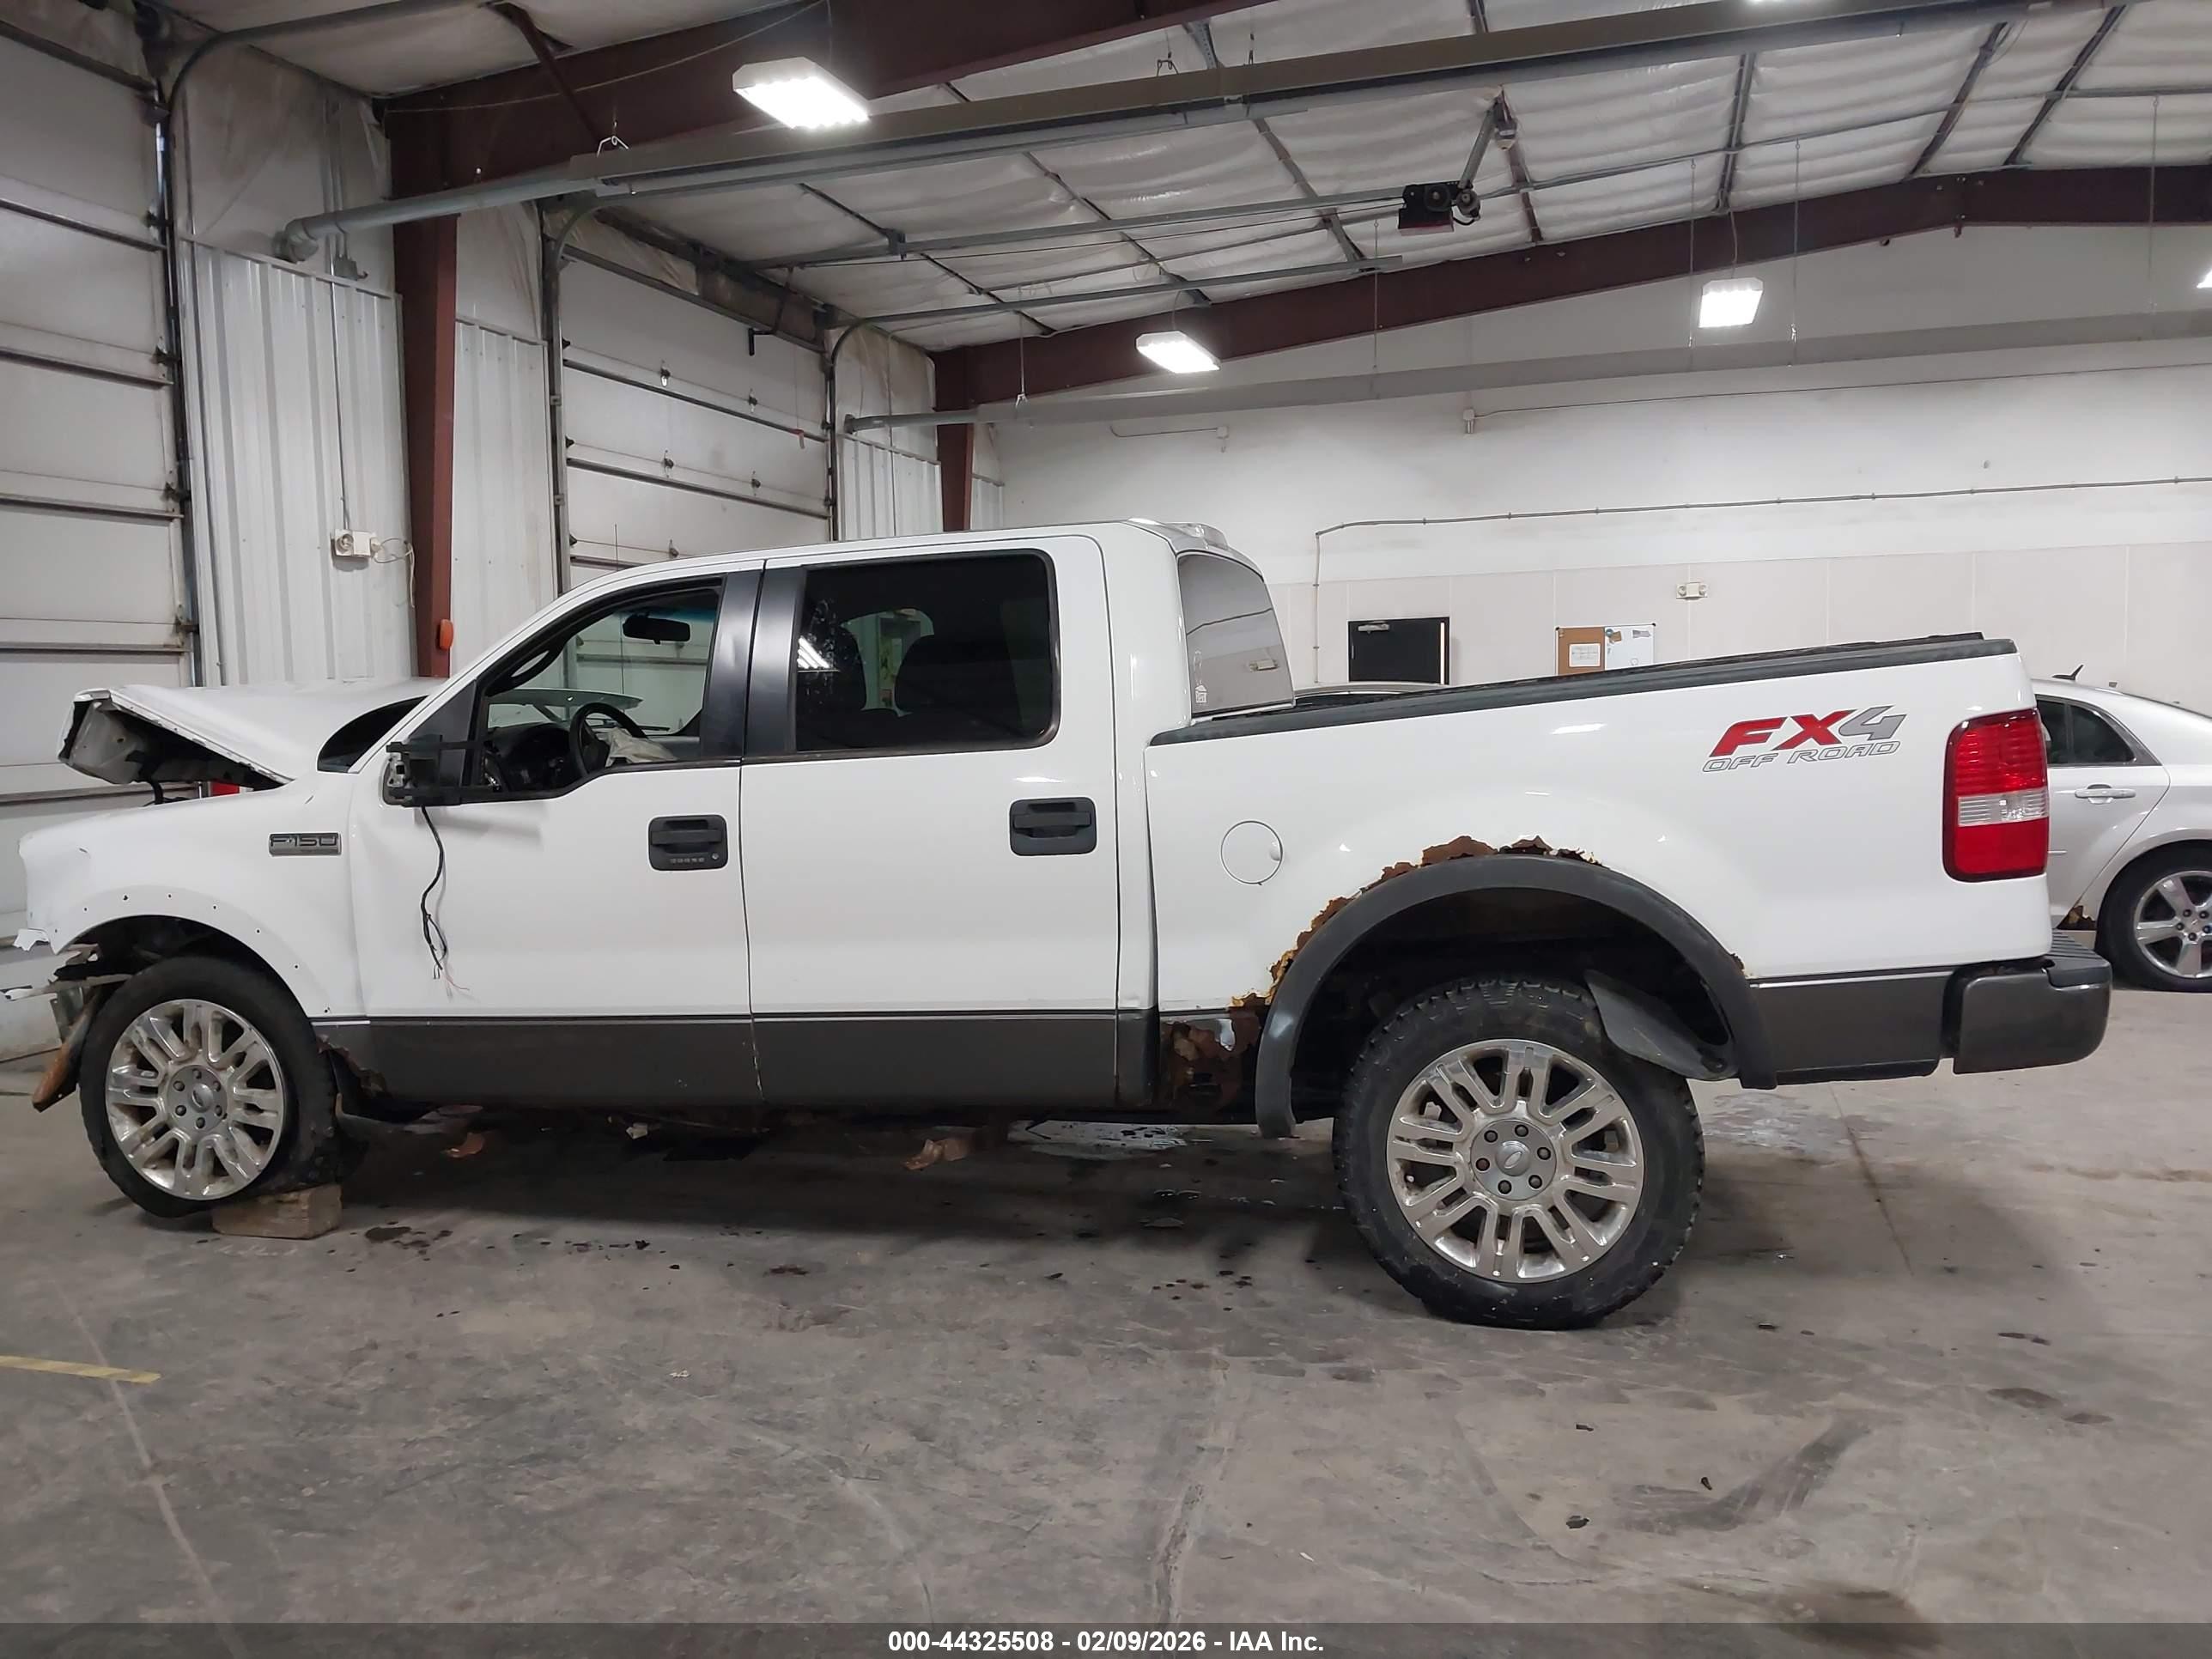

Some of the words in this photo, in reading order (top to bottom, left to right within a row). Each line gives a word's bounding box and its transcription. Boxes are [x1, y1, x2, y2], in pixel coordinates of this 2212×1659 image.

[1710, 705, 1907, 757] FX4
[1703, 752, 1779, 773] OFF
[1786, 740, 1901, 764] ROAD
